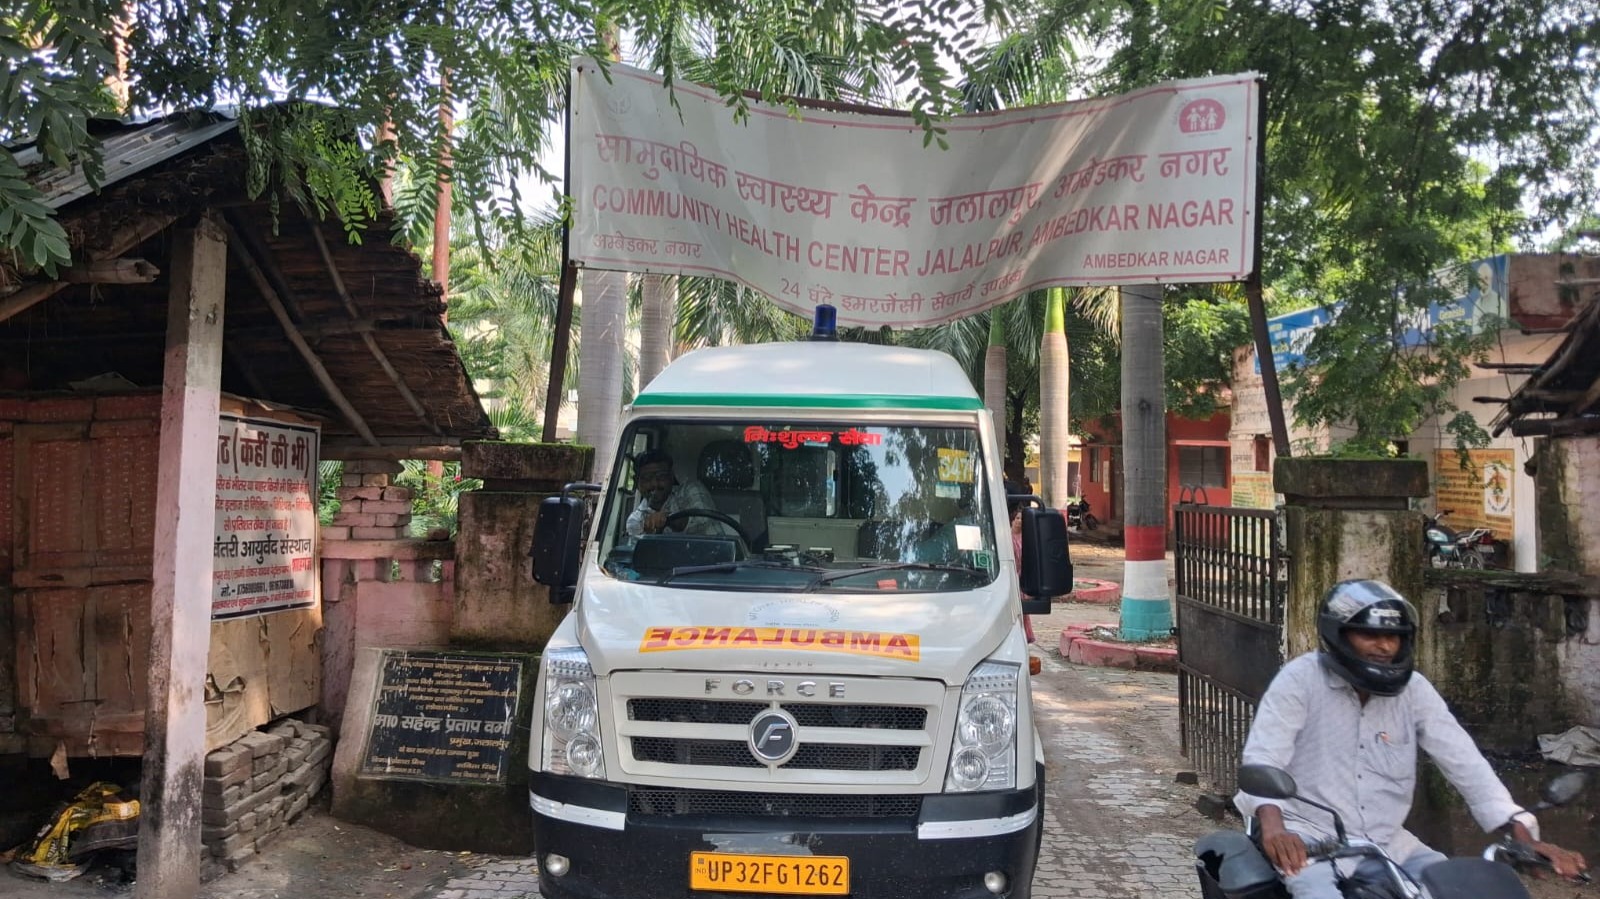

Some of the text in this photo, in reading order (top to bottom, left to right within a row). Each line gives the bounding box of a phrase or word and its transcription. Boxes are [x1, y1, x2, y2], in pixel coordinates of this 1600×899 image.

[595, 133, 727, 188] सामुदायिक
[735, 171, 838, 219] स्वास्थ्य
[850, 184, 917, 228] केन्द्र
[1054, 155, 1147, 197] अम्बेडकर
[1159, 148, 1232, 178] नगर
[592, 184, 1234, 277] COMMUNITY HEALTH CENTER JALALPUR, AMBEDKAR NAGAR
[593, 231, 702, 258] अम्बेडकर नगर
[1083, 249, 1229, 268] AMBEDKAR NAGAR
[781, 278, 800, 298] 24
[840, 292, 924, 314] इमरजेंसी
[838, 427, 882, 445] सेवा
[271, 433, 289, 469] की
[240, 533, 279, 565] आयुर्वेद
[280, 534, 311, 555] संस्थान
[704, 678, 847, 698] FORCE
[446, 716, 481, 734] प्रताप
[708, 860, 843, 886] UP32FG1262
